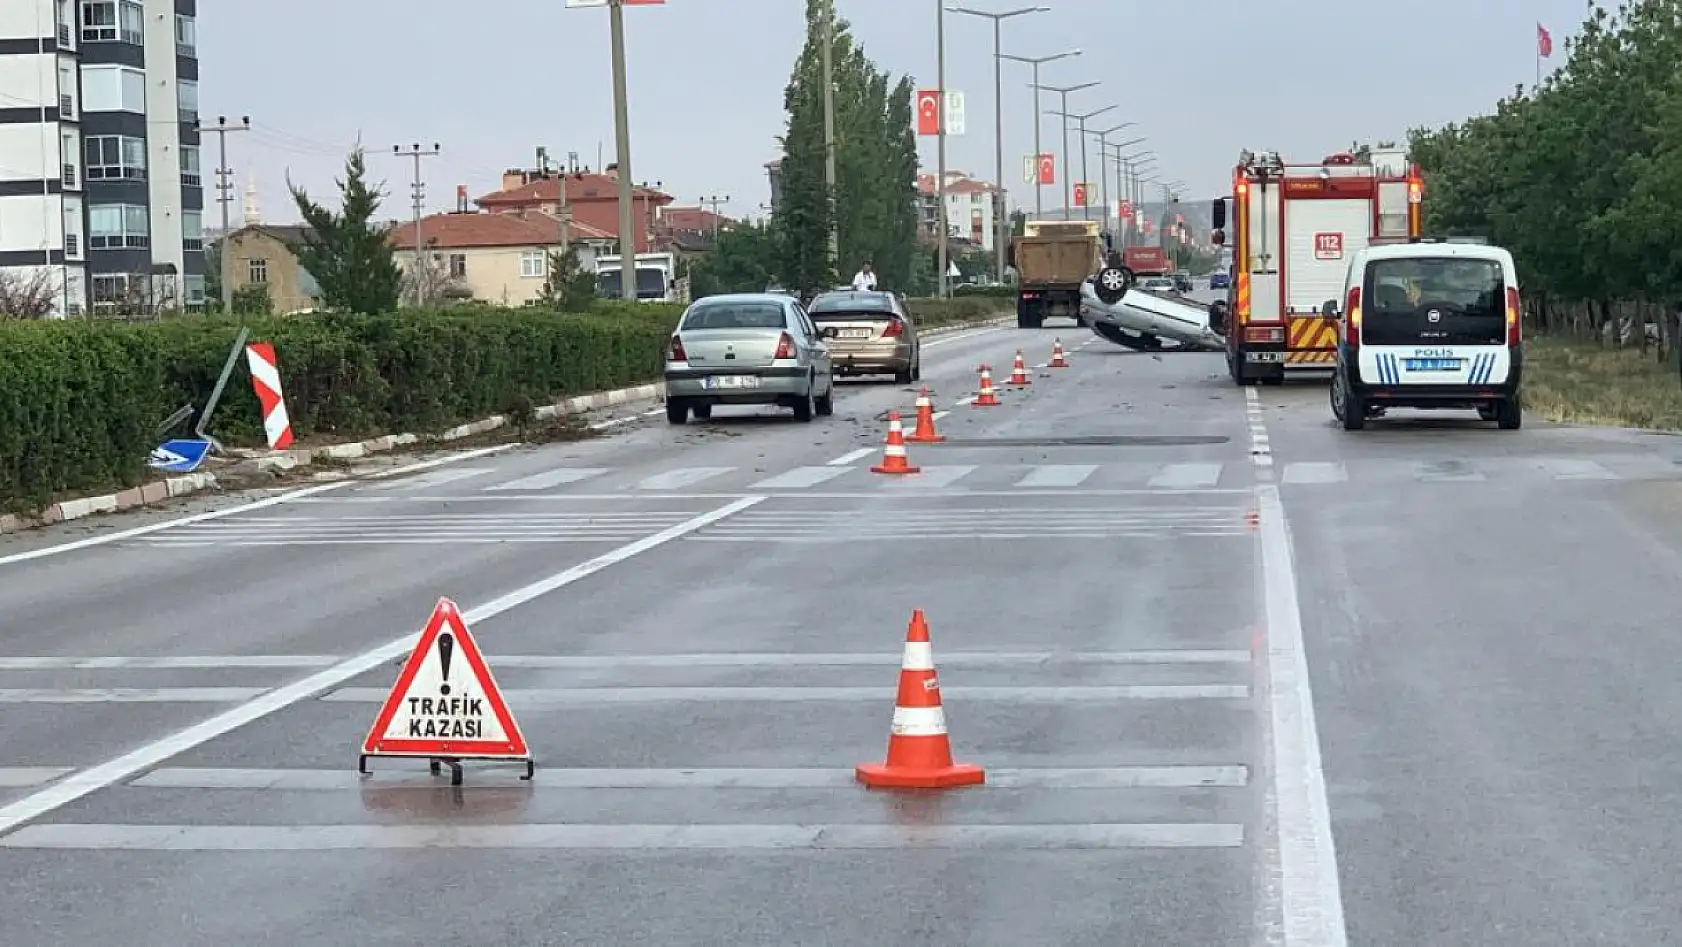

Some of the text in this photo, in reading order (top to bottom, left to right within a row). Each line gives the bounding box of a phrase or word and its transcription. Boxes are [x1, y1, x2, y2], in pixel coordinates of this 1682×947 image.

[1319, 235, 1339, 249] 112
[1415, 347, 1454, 357] POLİS
[408, 693, 482, 716] TRAFİK
[409, 718, 482, 738] KAZASI
